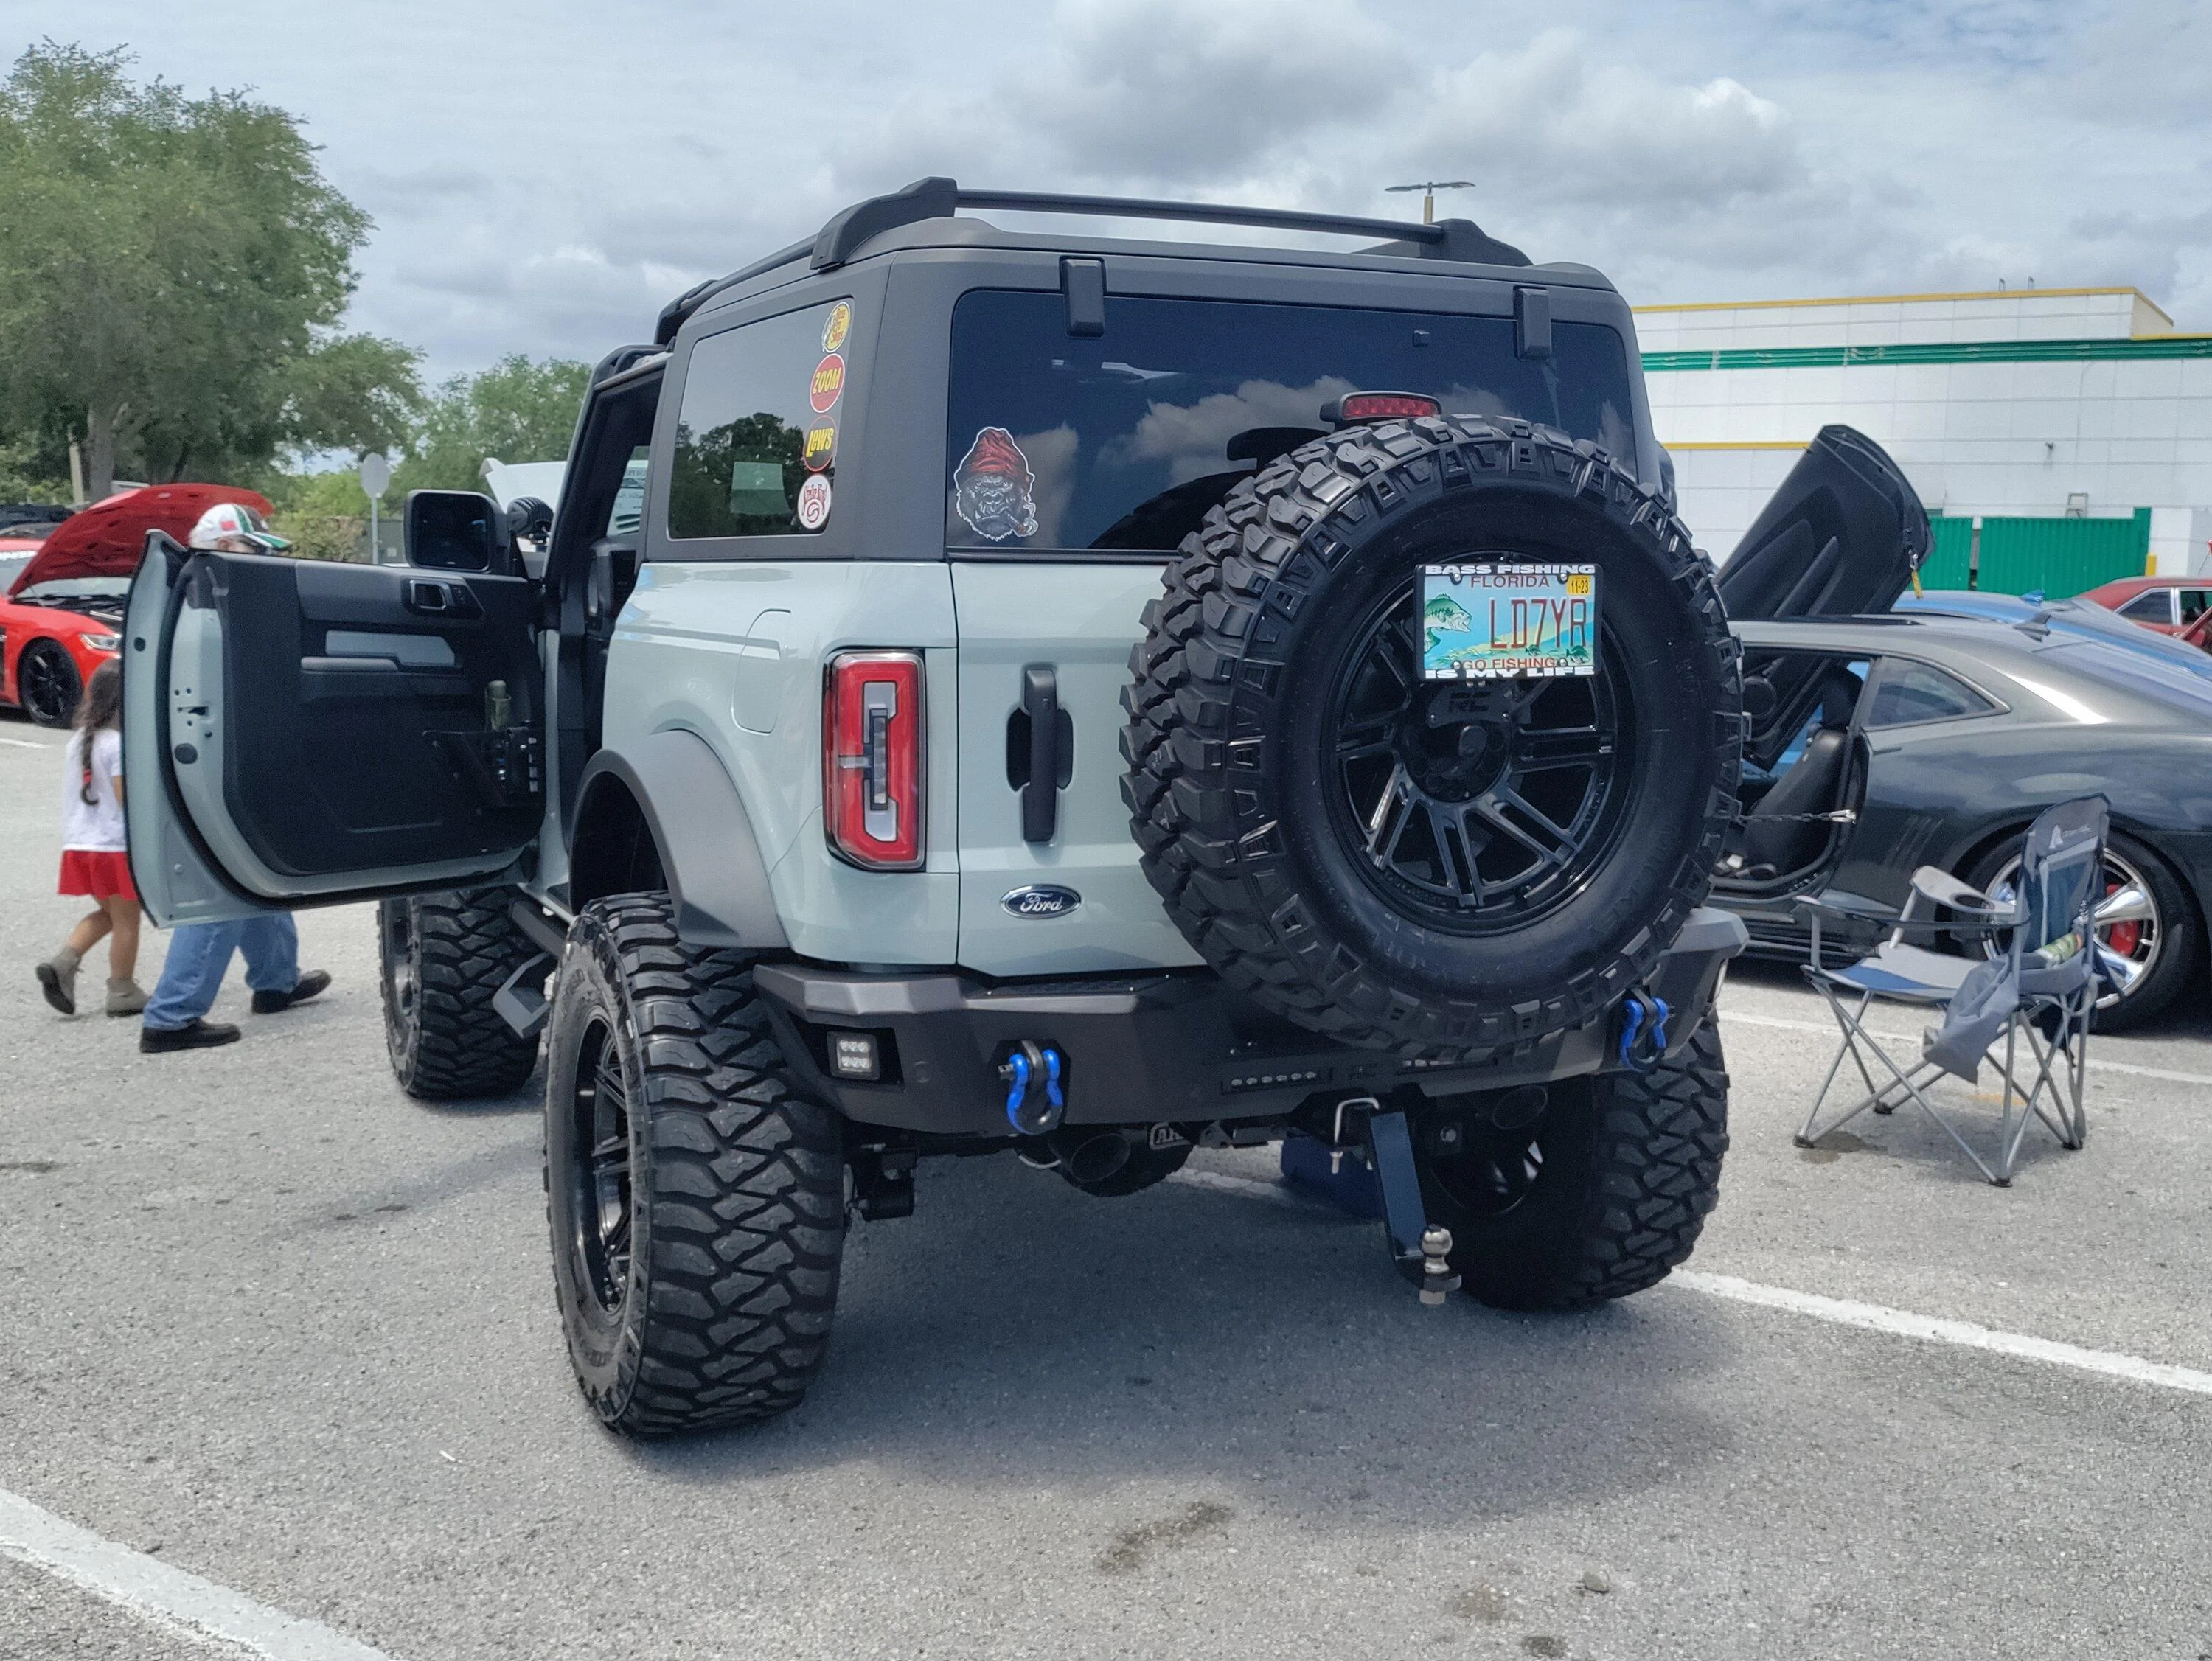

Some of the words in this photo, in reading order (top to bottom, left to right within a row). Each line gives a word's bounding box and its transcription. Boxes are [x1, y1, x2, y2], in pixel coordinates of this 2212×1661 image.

[812, 367, 842, 394] ZOOM
[1425, 565, 1492, 575] BASS
[1497, 565, 1596, 574] FISHING
[1470, 575, 1550, 588] FLORIDA
[1489, 598, 1587, 649] LD7YR
[1461, 659, 1487, 669] GO
[1492, 658, 1557, 669] FISHING
[1425, 669, 1458, 679] IS
[1466, 668, 1520, 678] MY
[1526, 666, 1595, 677] LIFE
[1020, 892, 1063, 913] Ford
